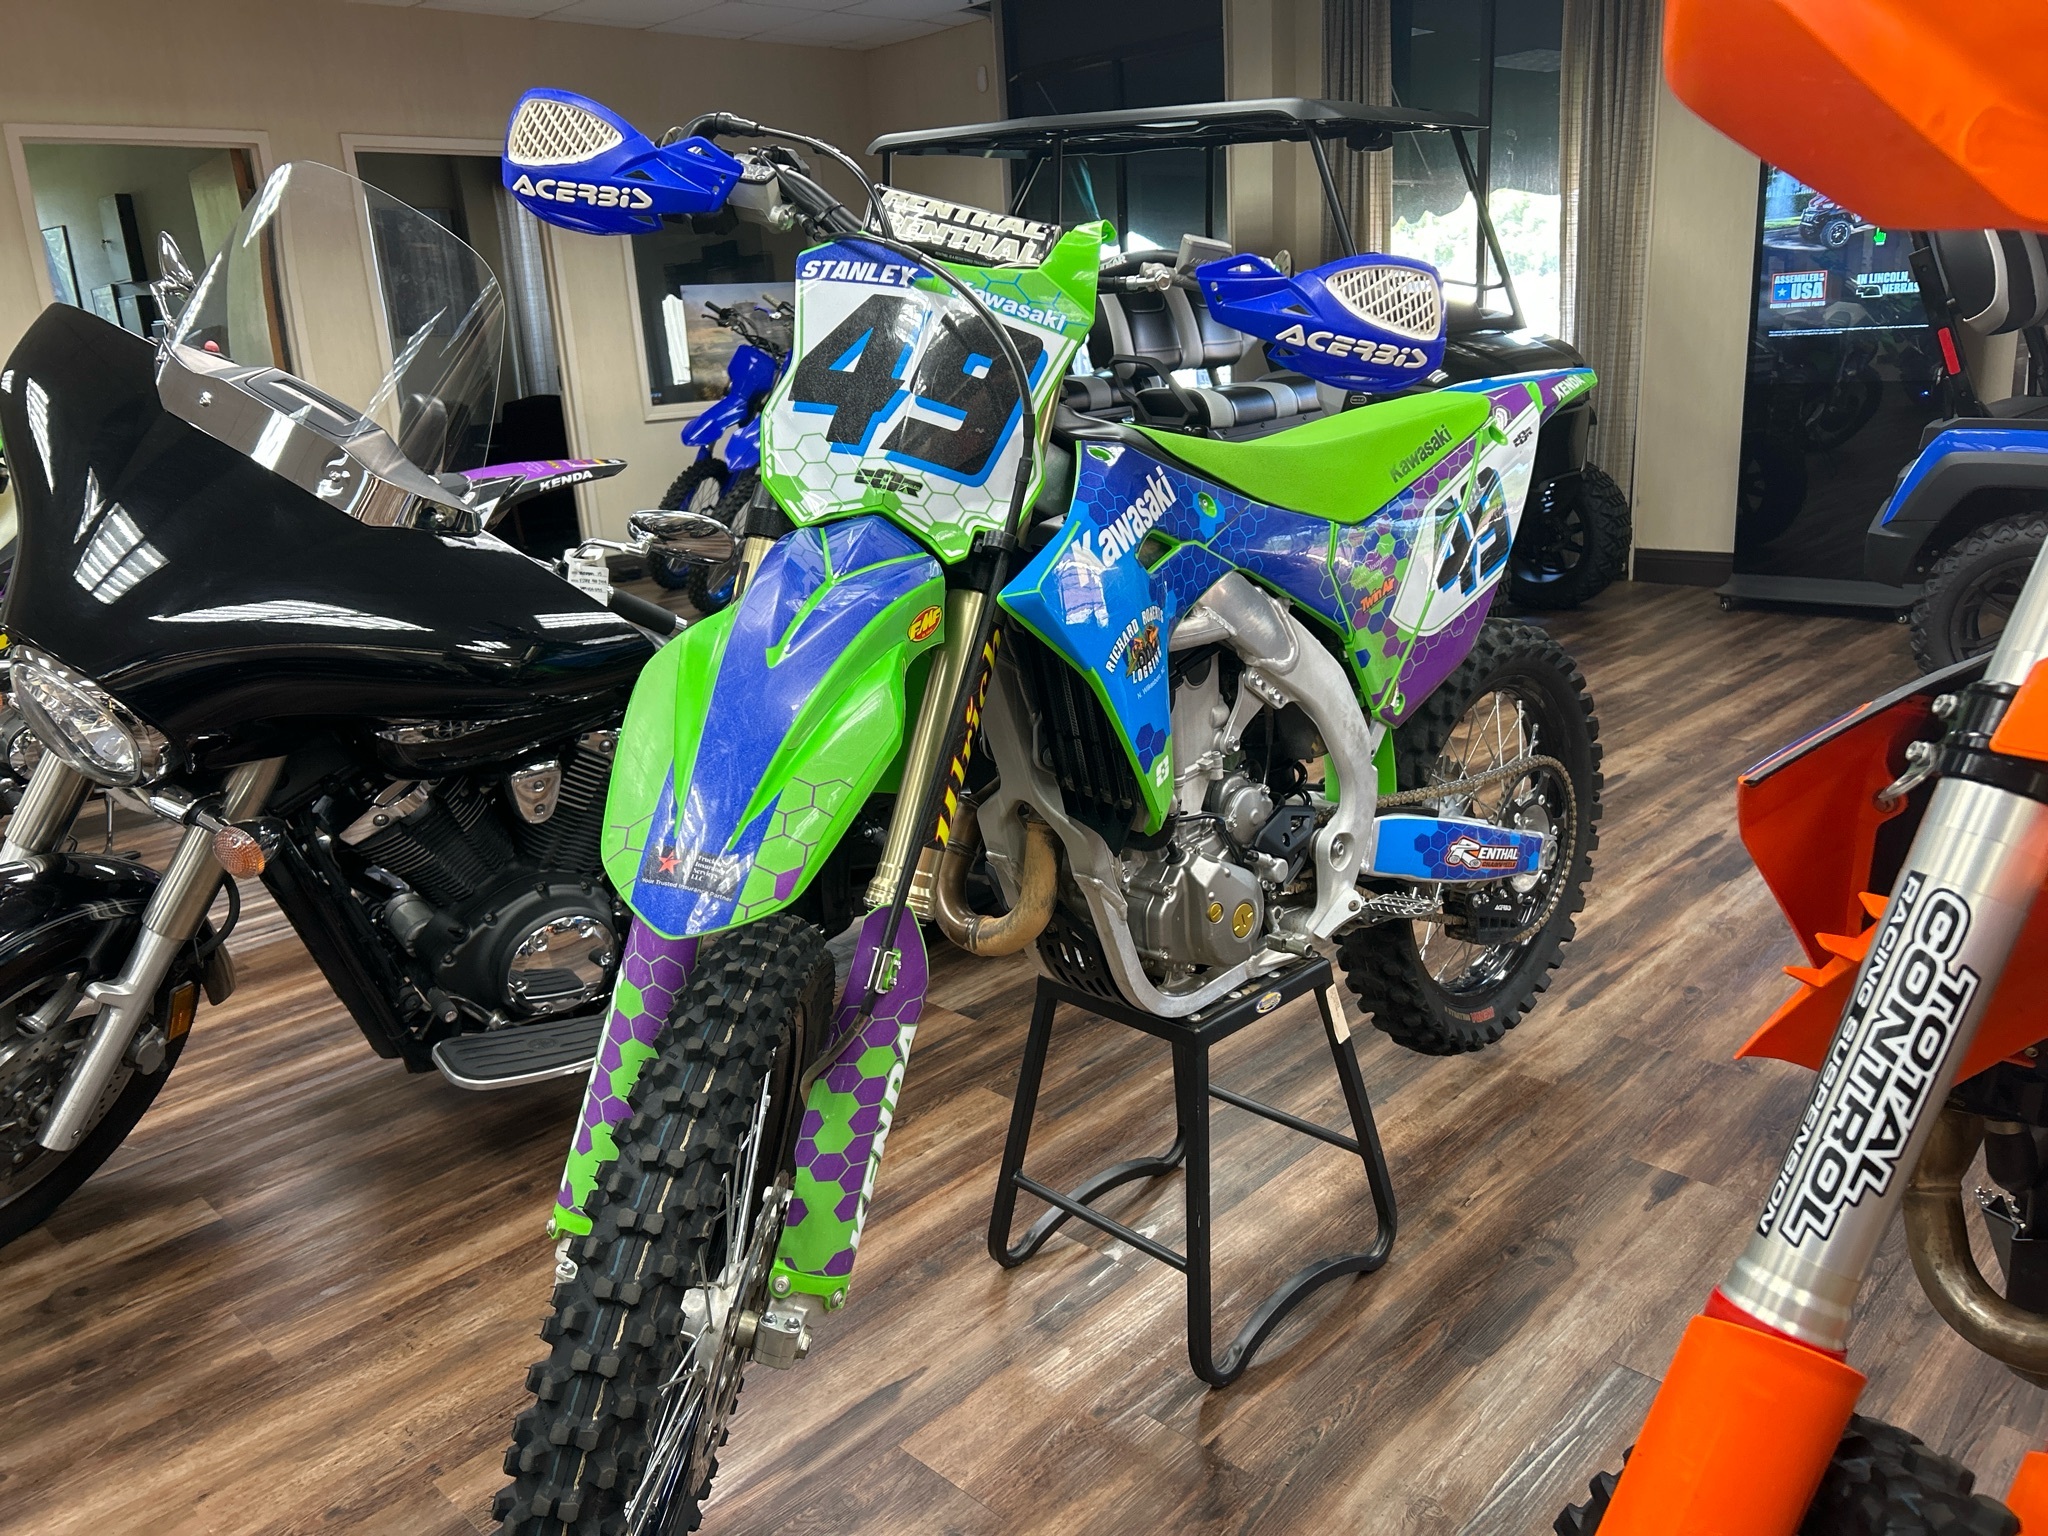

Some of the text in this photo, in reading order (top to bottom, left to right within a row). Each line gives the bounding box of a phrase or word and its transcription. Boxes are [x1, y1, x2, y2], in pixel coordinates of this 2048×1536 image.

[880, 189, 1048, 241] RENTHAL
[873, 213, 1041, 265] RENTHAL
[802, 260, 918, 288] STANLEY
[1774, 272, 1820, 285] ASSEMBLED
[1790, 281, 1824, 301] USA
[1882, 281, 1920, 295] NEBRAS
[788, 293, 1048, 487] 49
[1551, 374, 1586, 401] KENDA
[1389, 424, 1453, 483] Kawasaki
[539, 470, 593, 493] KENDA
[1070, 465, 1177, 588] Kawasaki
[1360, 577, 1395, 612] Twin Air
[908, 606, 943, 641] FMF
[1105, 618, 1139, 674] RICHARD
[642, 877, 655, 885] Your
[655, 879, 678, 888] Trusted
[709, 891, 733, 903] Partner
[1758, 873, 1924, 1236] RACING SUSPENSION
[1778, 888, 1971, 1247] CONTROL
[1844, 966, 1980, 1207] TOTAL
